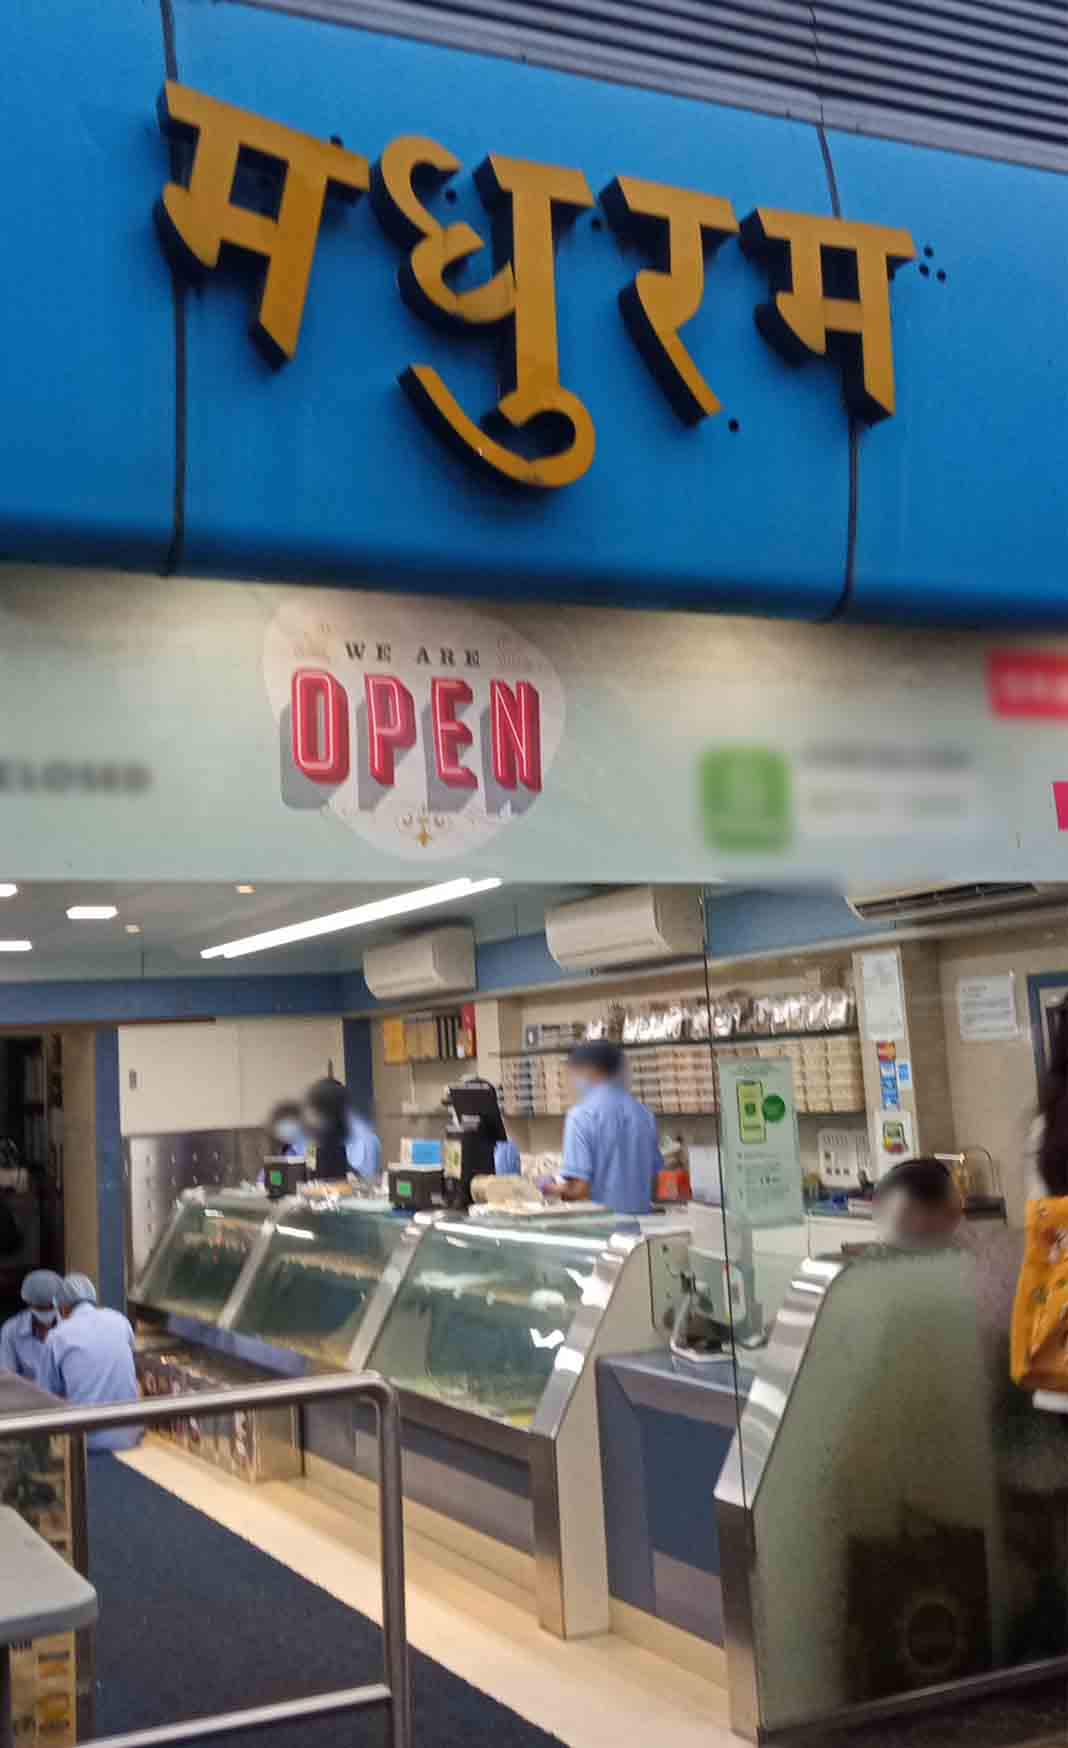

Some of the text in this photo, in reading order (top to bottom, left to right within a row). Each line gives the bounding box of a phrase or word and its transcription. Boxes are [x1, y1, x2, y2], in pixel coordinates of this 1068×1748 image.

[156, 80, 917, 488] मधुरम
[345, 642, 481, 667] WE ARE
[291, 668, 542, 792] OPEN
